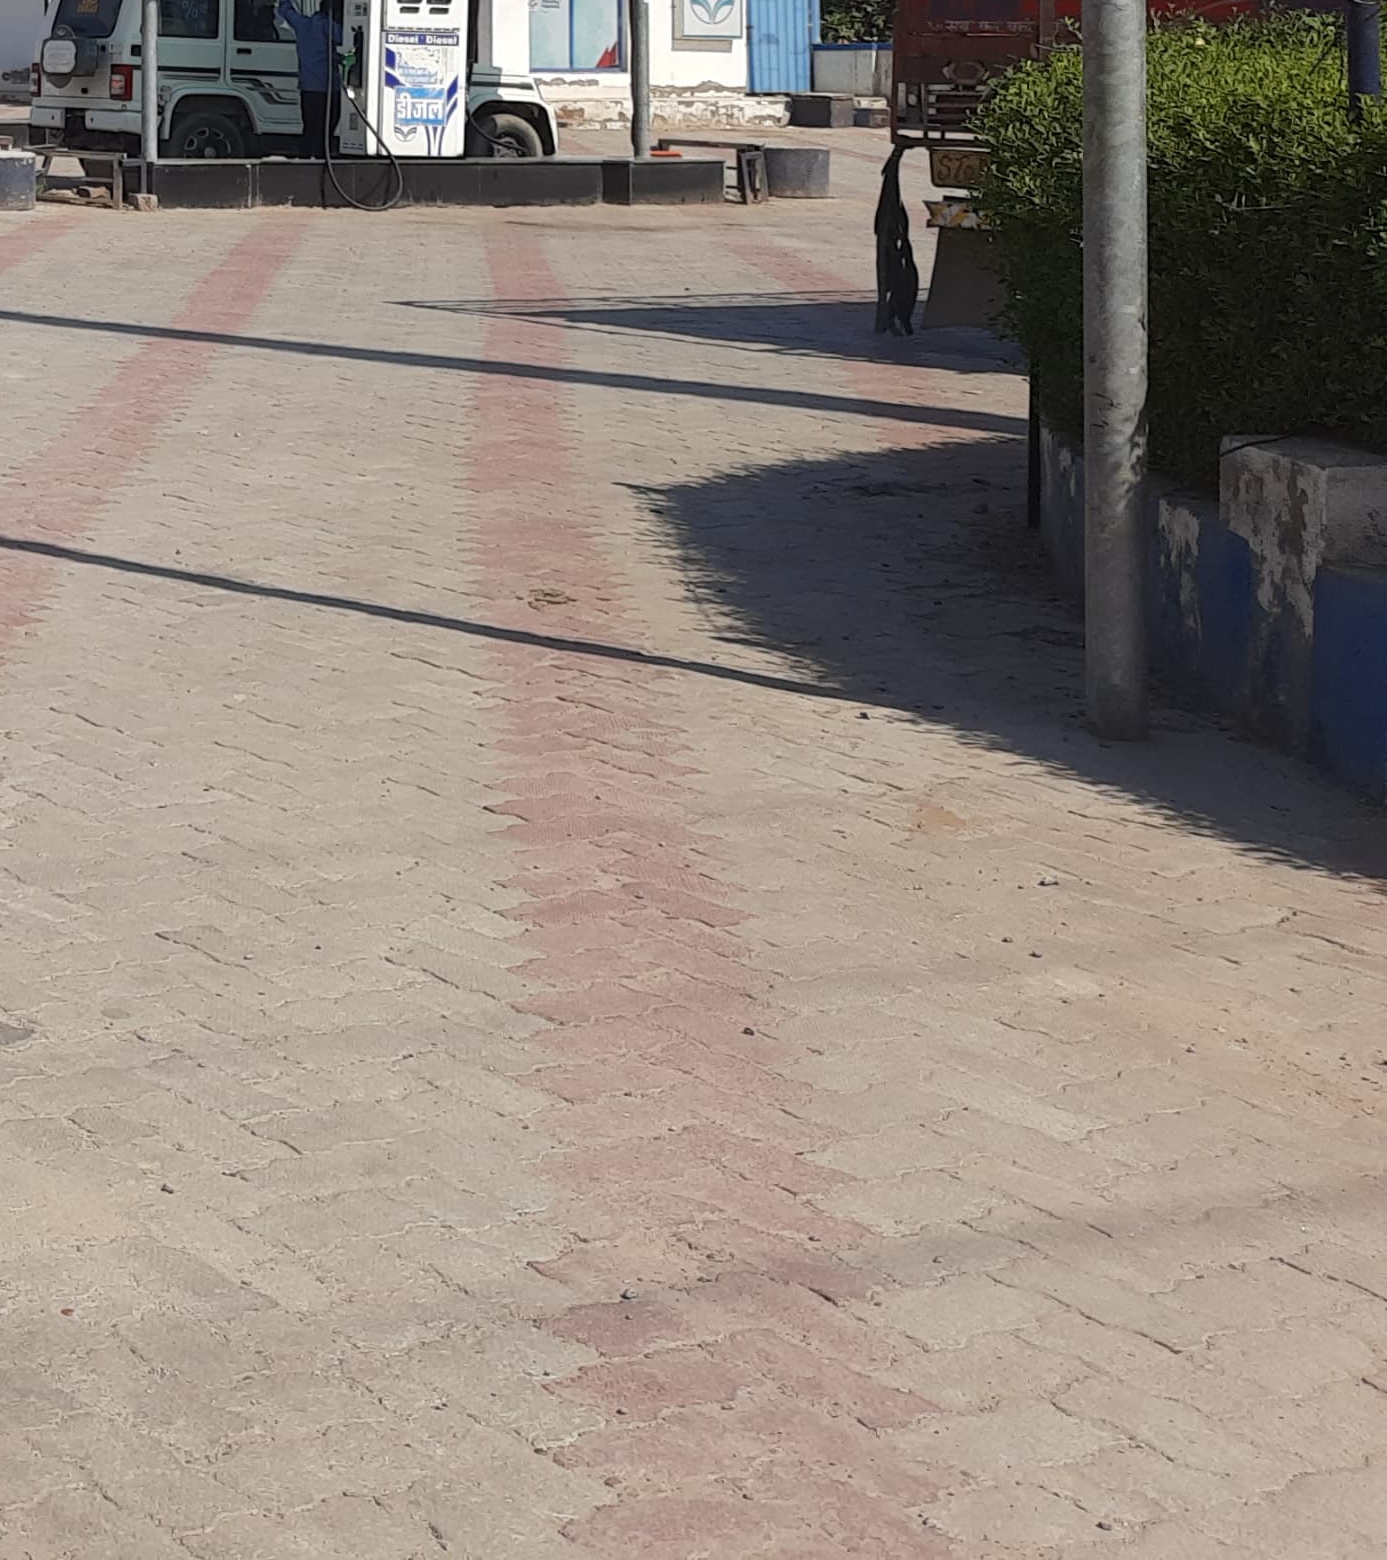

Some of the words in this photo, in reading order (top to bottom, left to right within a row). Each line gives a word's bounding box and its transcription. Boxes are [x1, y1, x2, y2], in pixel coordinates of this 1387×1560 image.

[387, 33, 419, 43] Diesel
[425, 34, 458, 44] Diesel
[395, 92, 445, 120] डीजल
